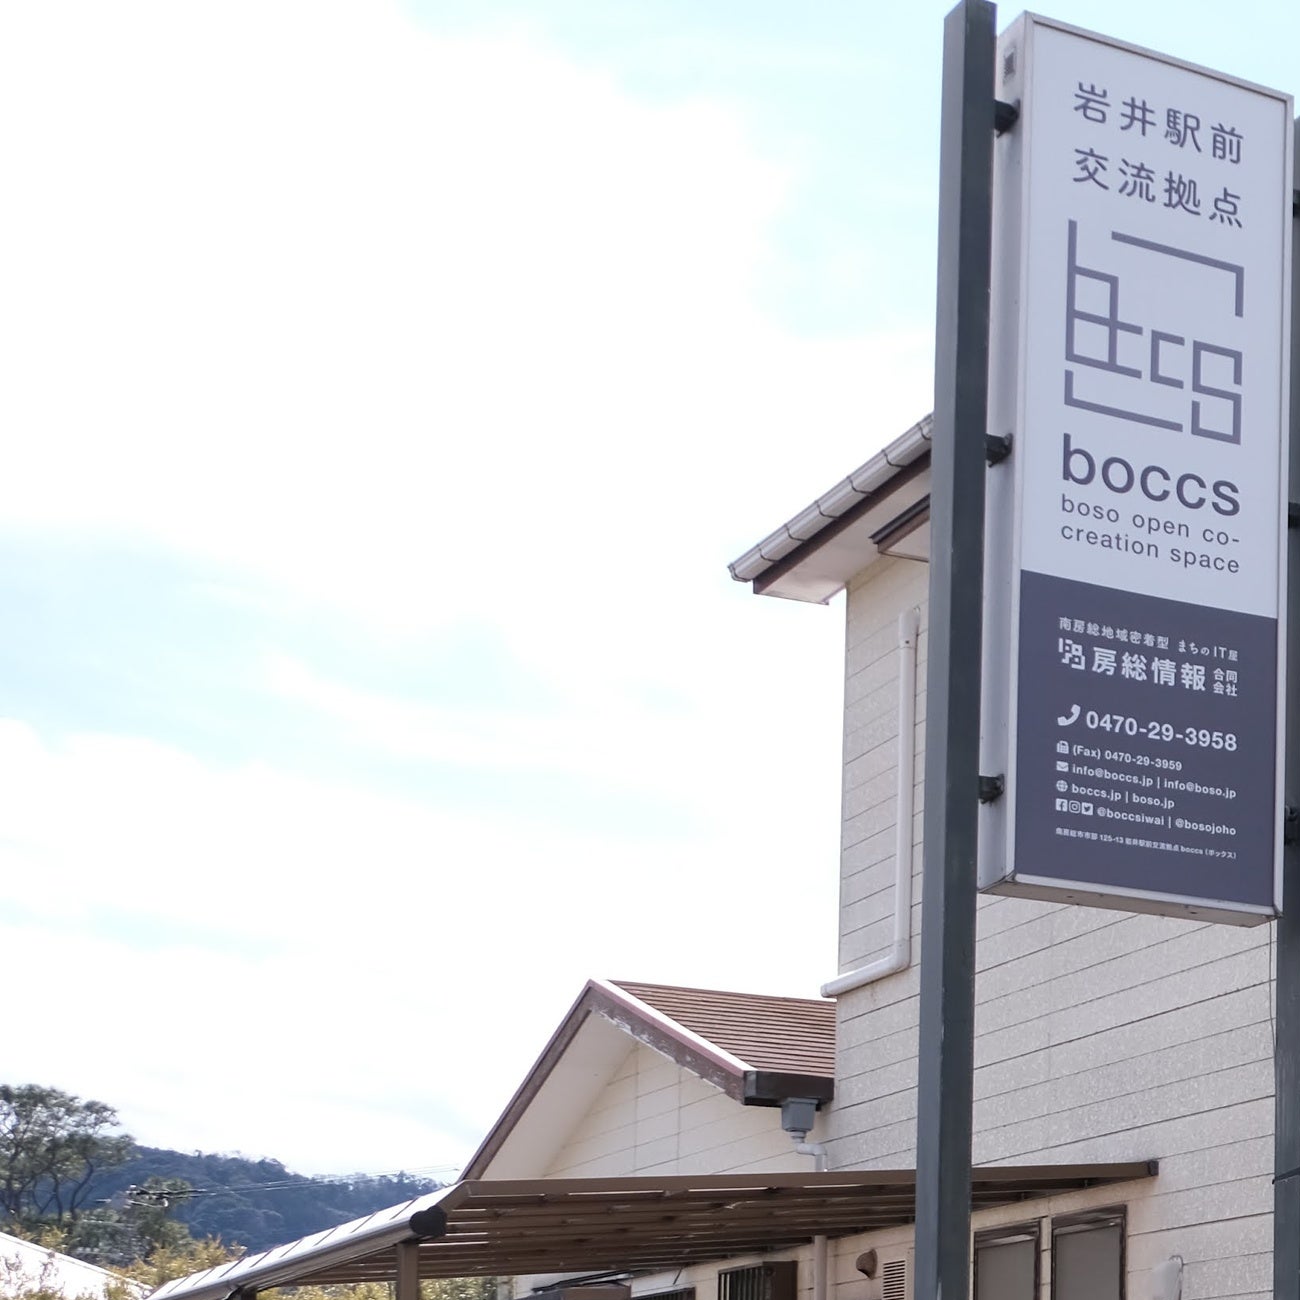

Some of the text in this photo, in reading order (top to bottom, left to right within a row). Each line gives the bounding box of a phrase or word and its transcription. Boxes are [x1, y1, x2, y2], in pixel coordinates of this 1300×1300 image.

[1073, 82, 1243, 164] 岩井駅前
[1073, 147, 1243, 228] 交流拠点
[1062, 433, 1240, 516] boccs
[1062, 494, 1240, 546] boso open co-
[1061, 525, 1240, 574] creation space
[1059, 617, 1169, 650] 南房総地域密着型
[1092, 647, 1206, 691] 房総情報
[1086, 710, 1237, 751] 0470-29-3958
[1073, 745, 1183, 772] (Fax) 0470-29-3959
[1071, 784, 1175, 809] boccs.jp boso.jp
[1072, 764, 1236, 800] info@boccs.jp info@boso.jp
[1097, 806, 1237, 836] @boccsiwai @bosojoho
